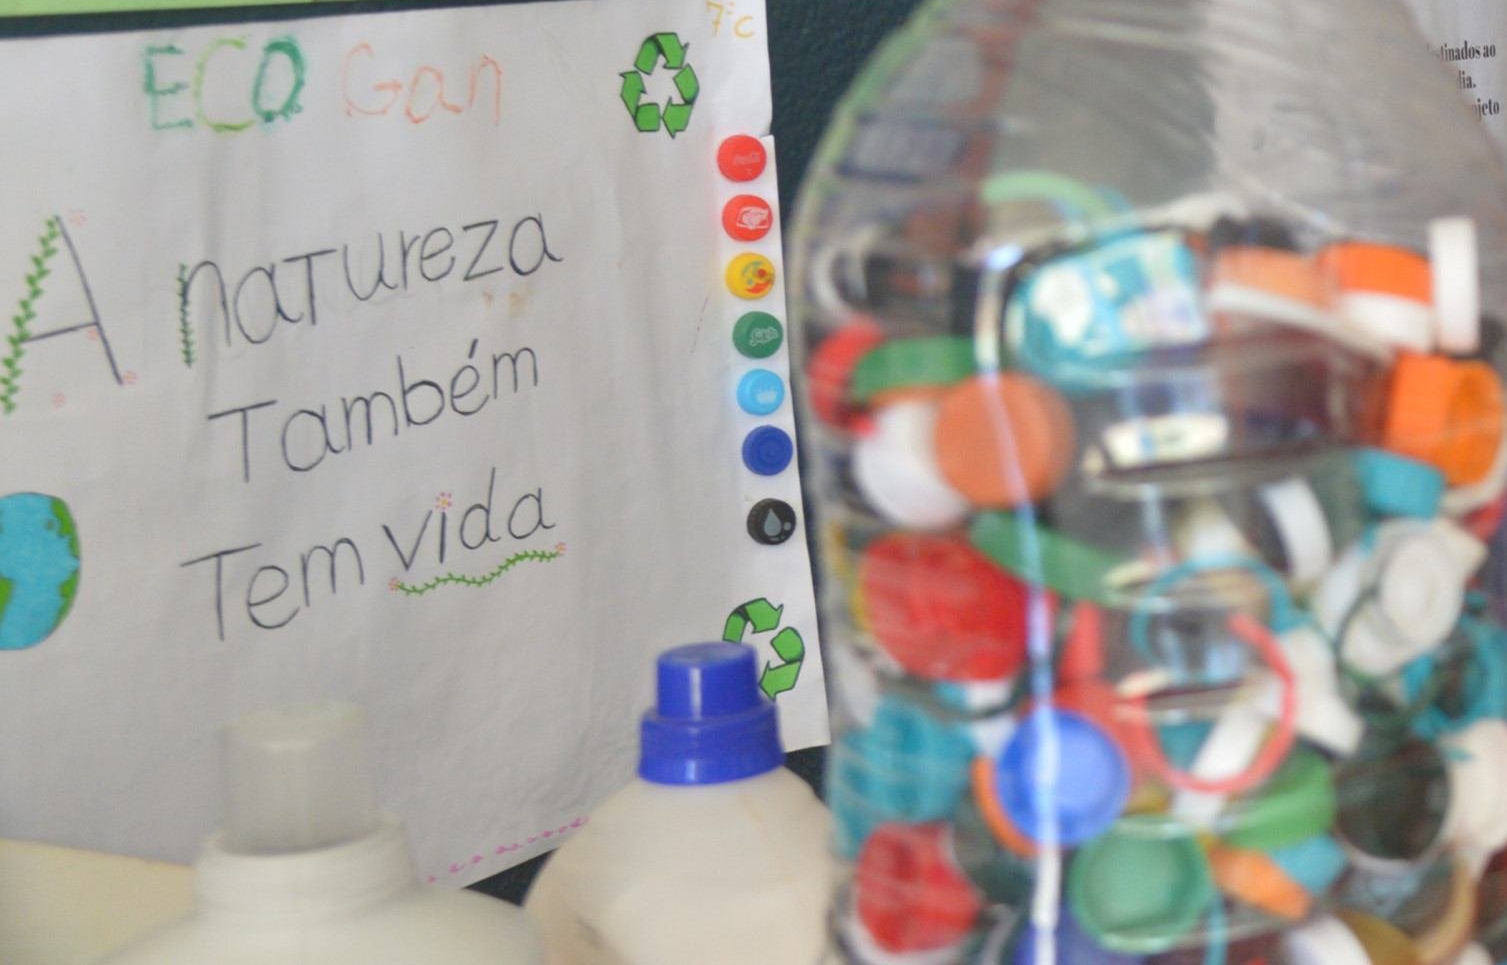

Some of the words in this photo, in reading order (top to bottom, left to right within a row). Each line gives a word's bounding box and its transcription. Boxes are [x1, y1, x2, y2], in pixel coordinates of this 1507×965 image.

[144, 35, 306, 133] ECO
[1483, 44, 1496, 57] ao
[0, 215, 124, 415] A
[206, 338, 538, 483] Também
[180, 537, 364, 641] Tem
